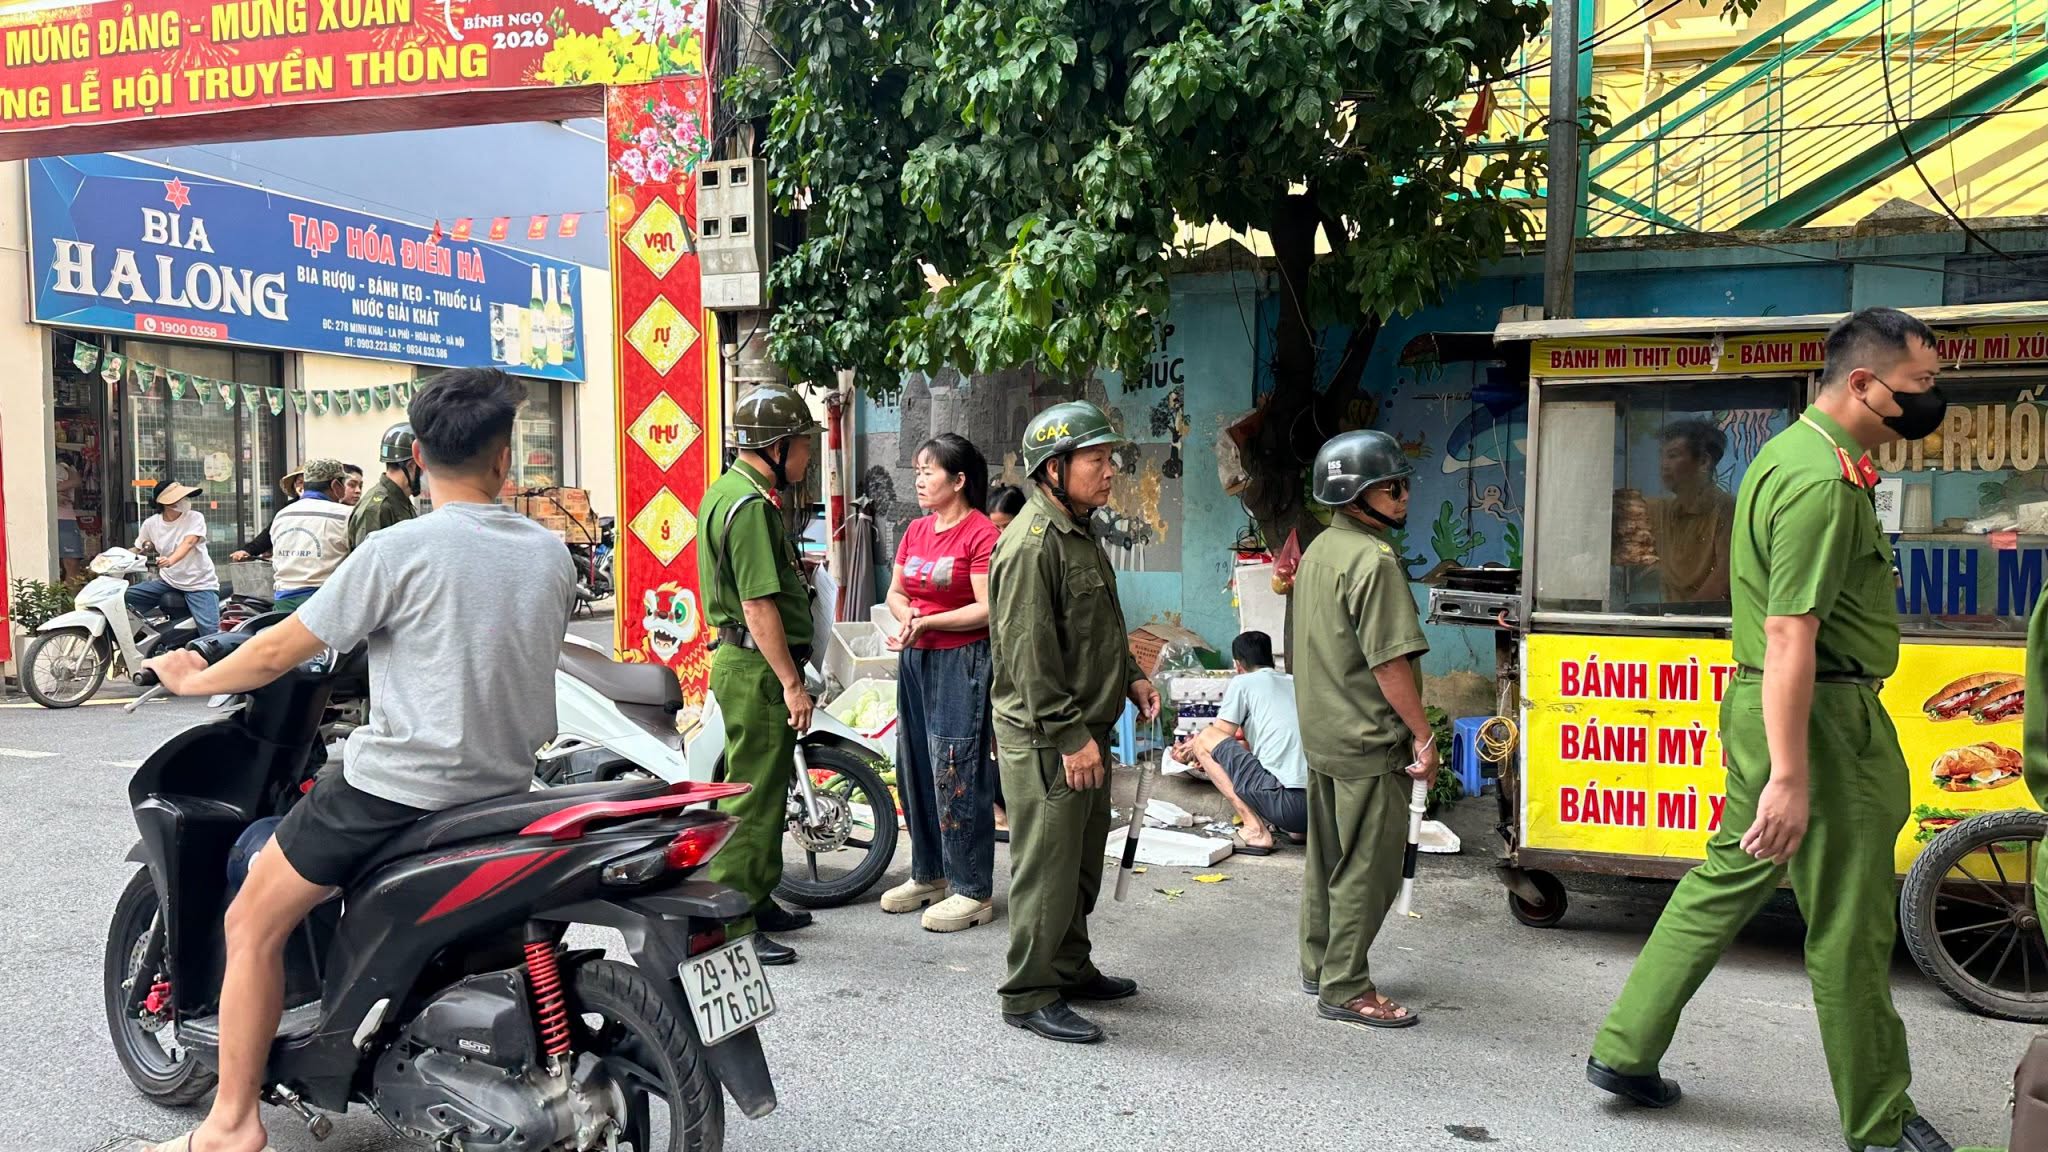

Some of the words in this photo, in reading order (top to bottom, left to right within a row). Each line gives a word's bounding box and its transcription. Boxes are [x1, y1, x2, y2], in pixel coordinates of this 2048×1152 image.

[99, 5, 180, 56] ĐẢNG
[463, 14, 504, 30] BÍNH
[509, 11, 545, 29] NGỌ
[492, 29, 549, 49] 2026
[0, 86, 50, 120] NG
[61, 68, 101, 115] LỄ
[112, 66, 172, 113] HỘI
[184, 47, 333, 102] TRUYỀN
[345, 33, 488, 87] THỐNG
[141, 207, 215, 254] BIA
[288, 213, 340, 259] TẠP
[346, 223, 396, 267] HÓA
[457, 247, 486, 284] HÀ
[644, 232, 676, 253] VẠN
[297, 265, 318, 285] BIA
[322, 269, 355, 294] RƯỢU
[368, 274, 399, 299] BÁNH
[402, 283, 422, 305] KẸO
[433, 288, 467, 310] THUỐC
[469, 294, 482, 313] LÁ
[352, 296, 384, 319] NƯỚC
[387, 300, 409, 323] GIẢI
[412, 306, 440, 327] KHÁT
[160, 321, 187, 335] 1900
[190, 325, 218, 338] 0358
[350, 323, 367, 335] MINH
[368, 327, 383, 337] KHAI
[388, 327, 398, 338] LA
[653, 326, 671, 348] SỰ
[1935, 334, 1977, 360] ÁNH
[1984, 333, 2010, 358] MÌ
[1551, 344, 1599, 369] BÁNH
[1604, 343, 1627, 368] MÌ
[1633, 347, 1669, 371] THỊT
[1676, 346, 1724, 368] QUA
[1740, 340, 1793, 364] BÁNH
[649, 424, 679, 444] NHƯ
[1036, 422, 1070, 442] CAX
[1943, 384, 2048, 473] RUỐ
[1998, 548, 2048, 616] M
[1561, 654, 1647, 699] BÁNH
[1659, 657, 1698, 701] MÌ
[1709, 665, 1736, 702] T
[1561, 718, 1646, 763] BÁNH
[1658, 722, 1707, 766] MỲ
[1560, 781, 1645, 827] BÁNH
[1657, 786, 1697, 830] MÌ
[693, 945, 752, 997] 29-X5
[699, 979, 771, 1039] 776.62
